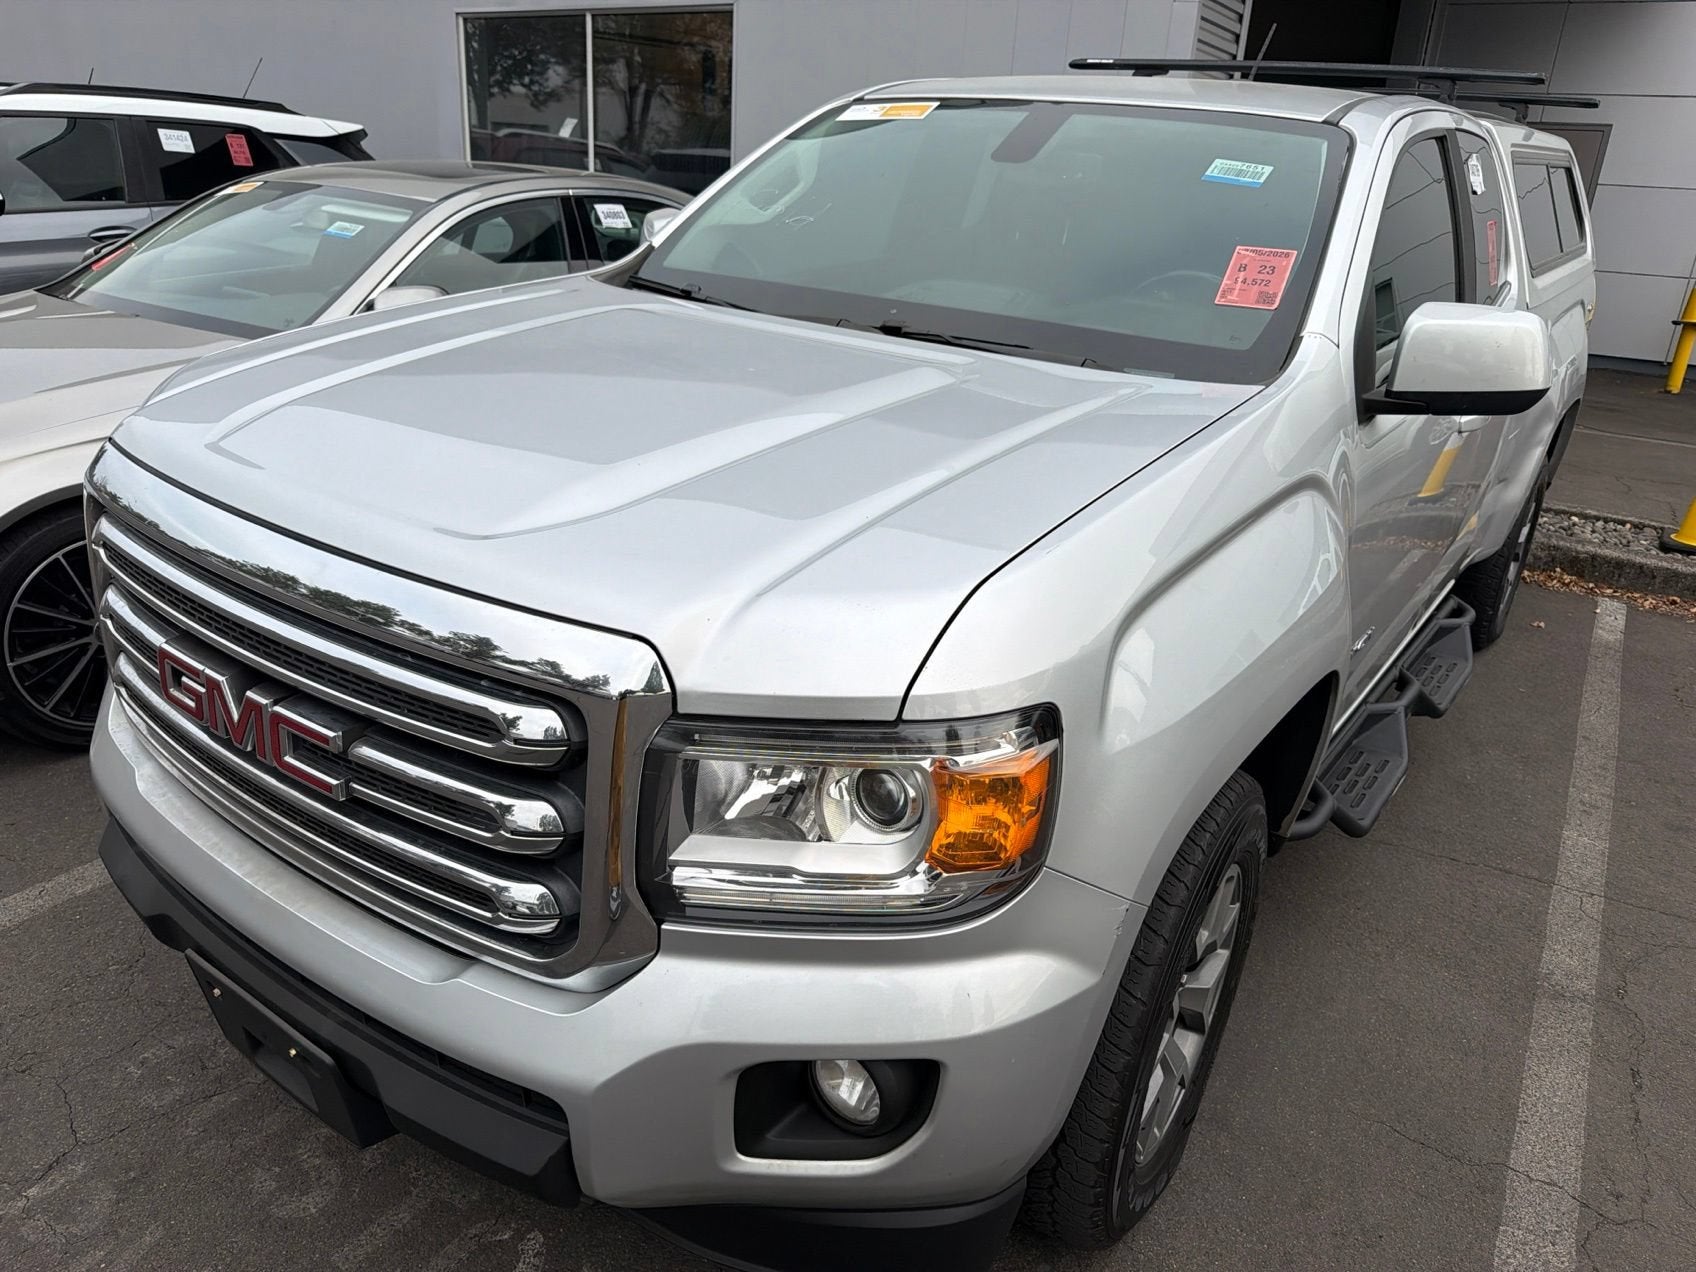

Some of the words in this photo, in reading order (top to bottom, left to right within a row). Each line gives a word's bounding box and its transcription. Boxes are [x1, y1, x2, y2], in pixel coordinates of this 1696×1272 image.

[1237, 263, 1248, 272] B
[1257, 264, 1276, 275] 23
[157, 641, 347, 802] GMC
